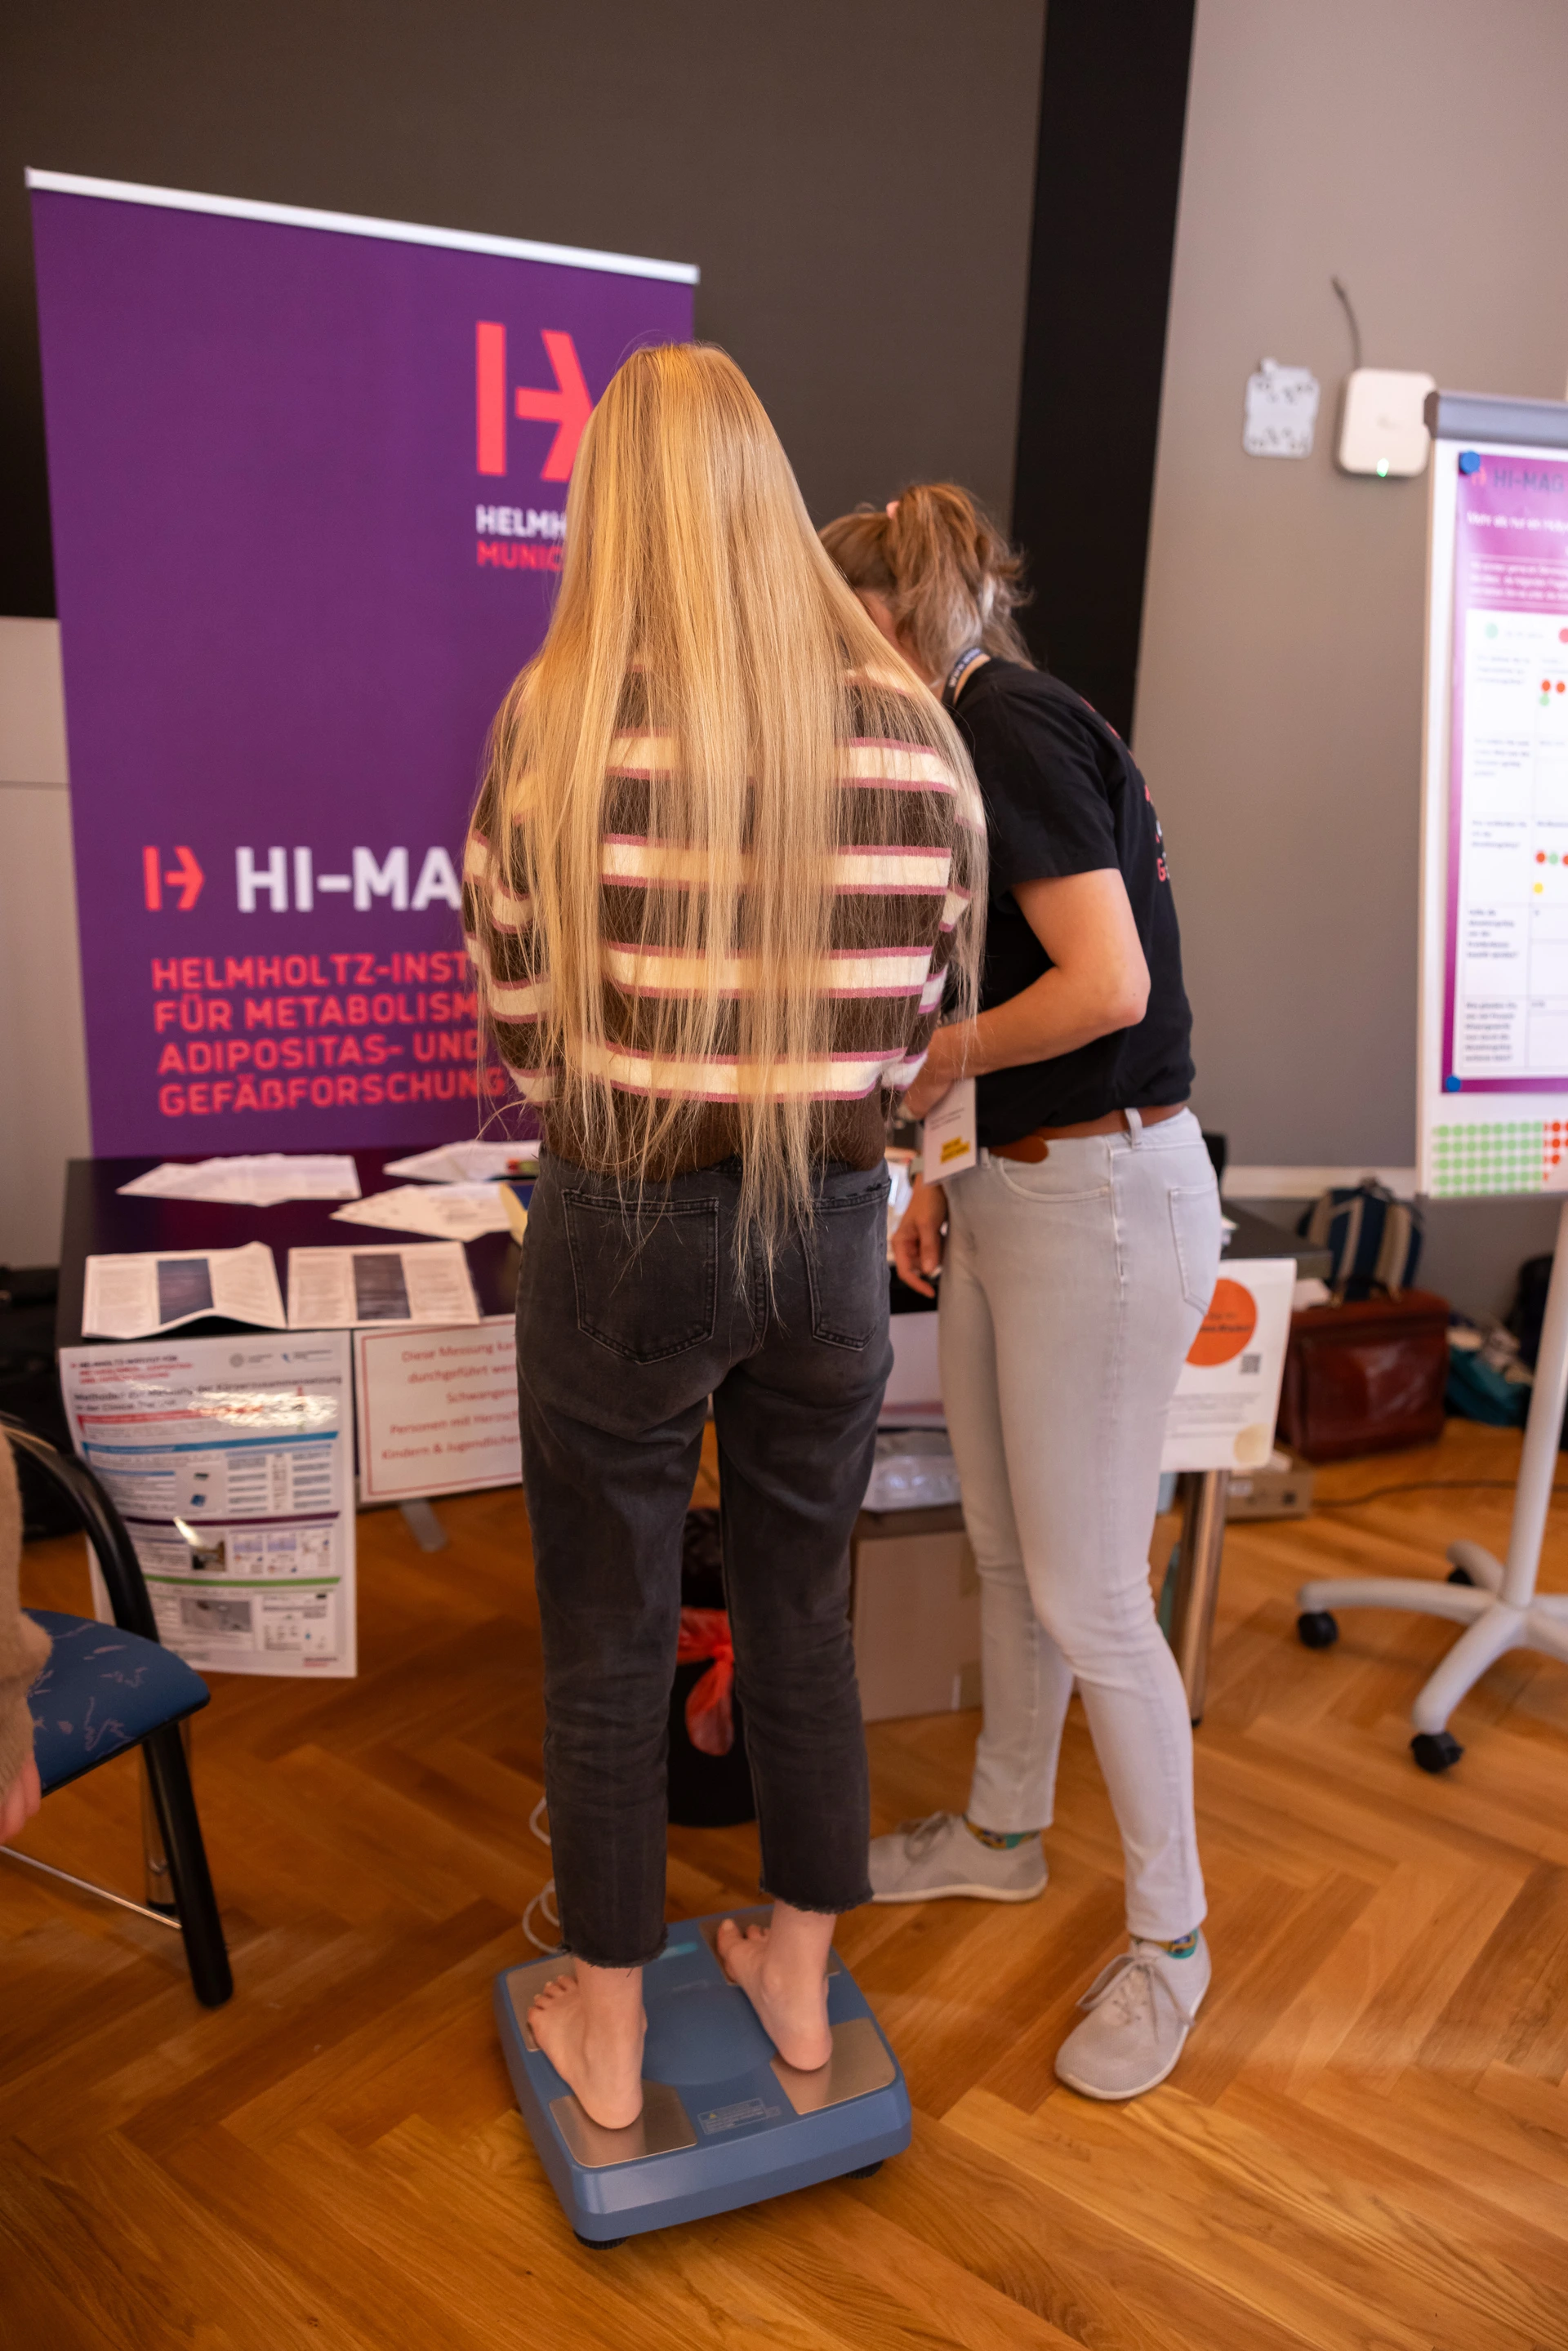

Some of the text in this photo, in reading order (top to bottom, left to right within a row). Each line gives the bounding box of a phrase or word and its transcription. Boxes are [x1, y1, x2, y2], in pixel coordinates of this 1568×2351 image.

[154, 993, 233, 1034] FÜR
[158, 1030, 486, 1075] ADIPOSITAS- UND
[401, 1351, 436, 1363] Diese
[439, 1344, 494, 1357] Messung
[408, 1365, 488, 1384] durchgeführt
[390, 1419, 448, 1435] Personen
[381, 1447, 430, 1459] Kindern
